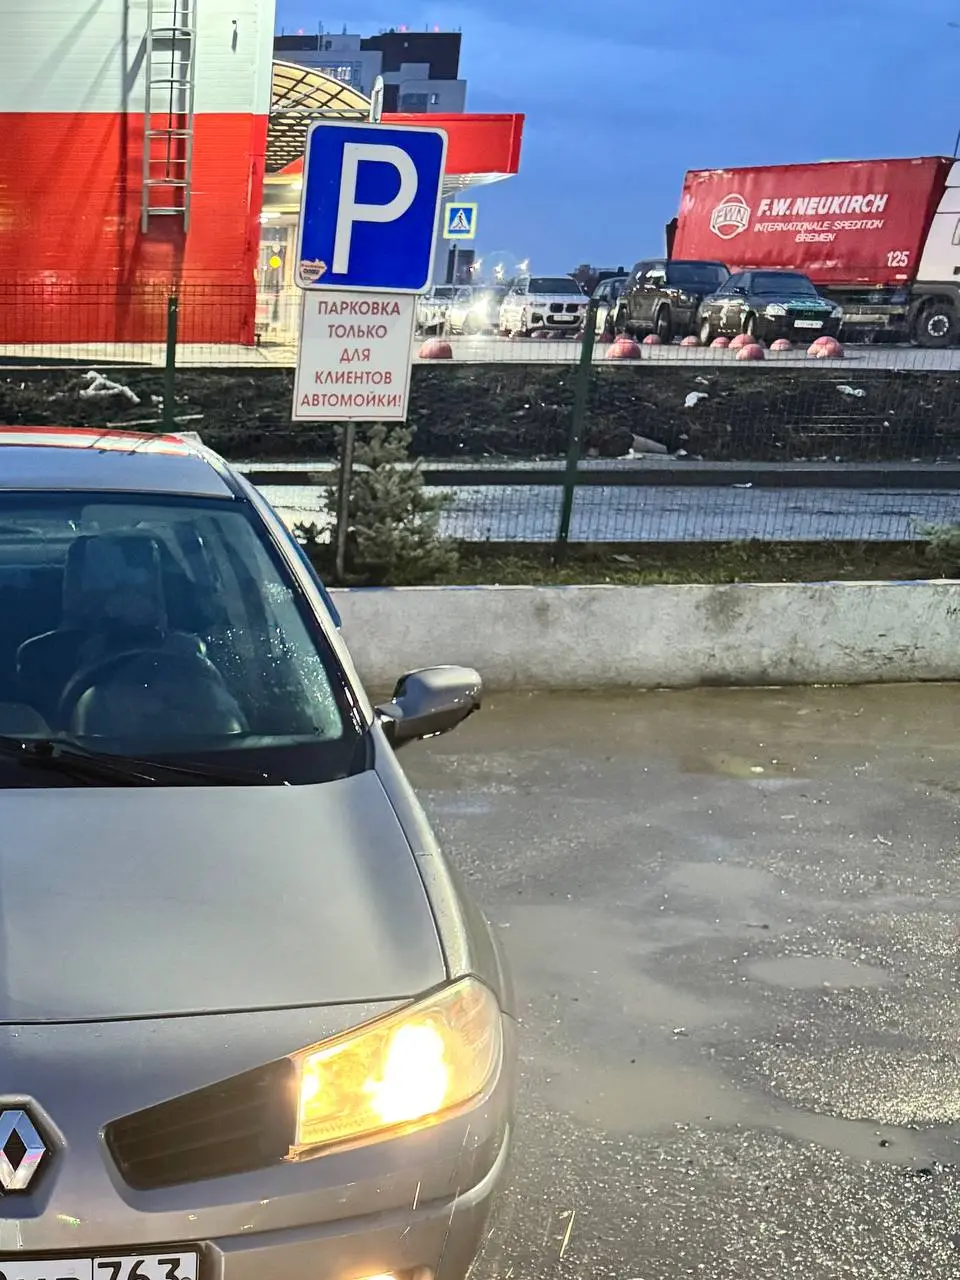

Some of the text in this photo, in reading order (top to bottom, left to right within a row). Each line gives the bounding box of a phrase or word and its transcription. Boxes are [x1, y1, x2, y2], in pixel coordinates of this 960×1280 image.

[332, 142, 419, 275] P
[754, 219, 884, 232] INTERNATIONALE SPEDITION
[795, 232, 836, 242] BREMEN
[887, 250, 910, 267] 125
[318, 300, 401, 316] ПАРКОВКА
[327, 324, 388, 339] ТОЛЬКО
[339, 347, 371, 364] ДЛЯ
[314, 371, 393, 385] КЛИЕНТОВ
[300, 391, 402, 407] АВТОМОЙКИ!
